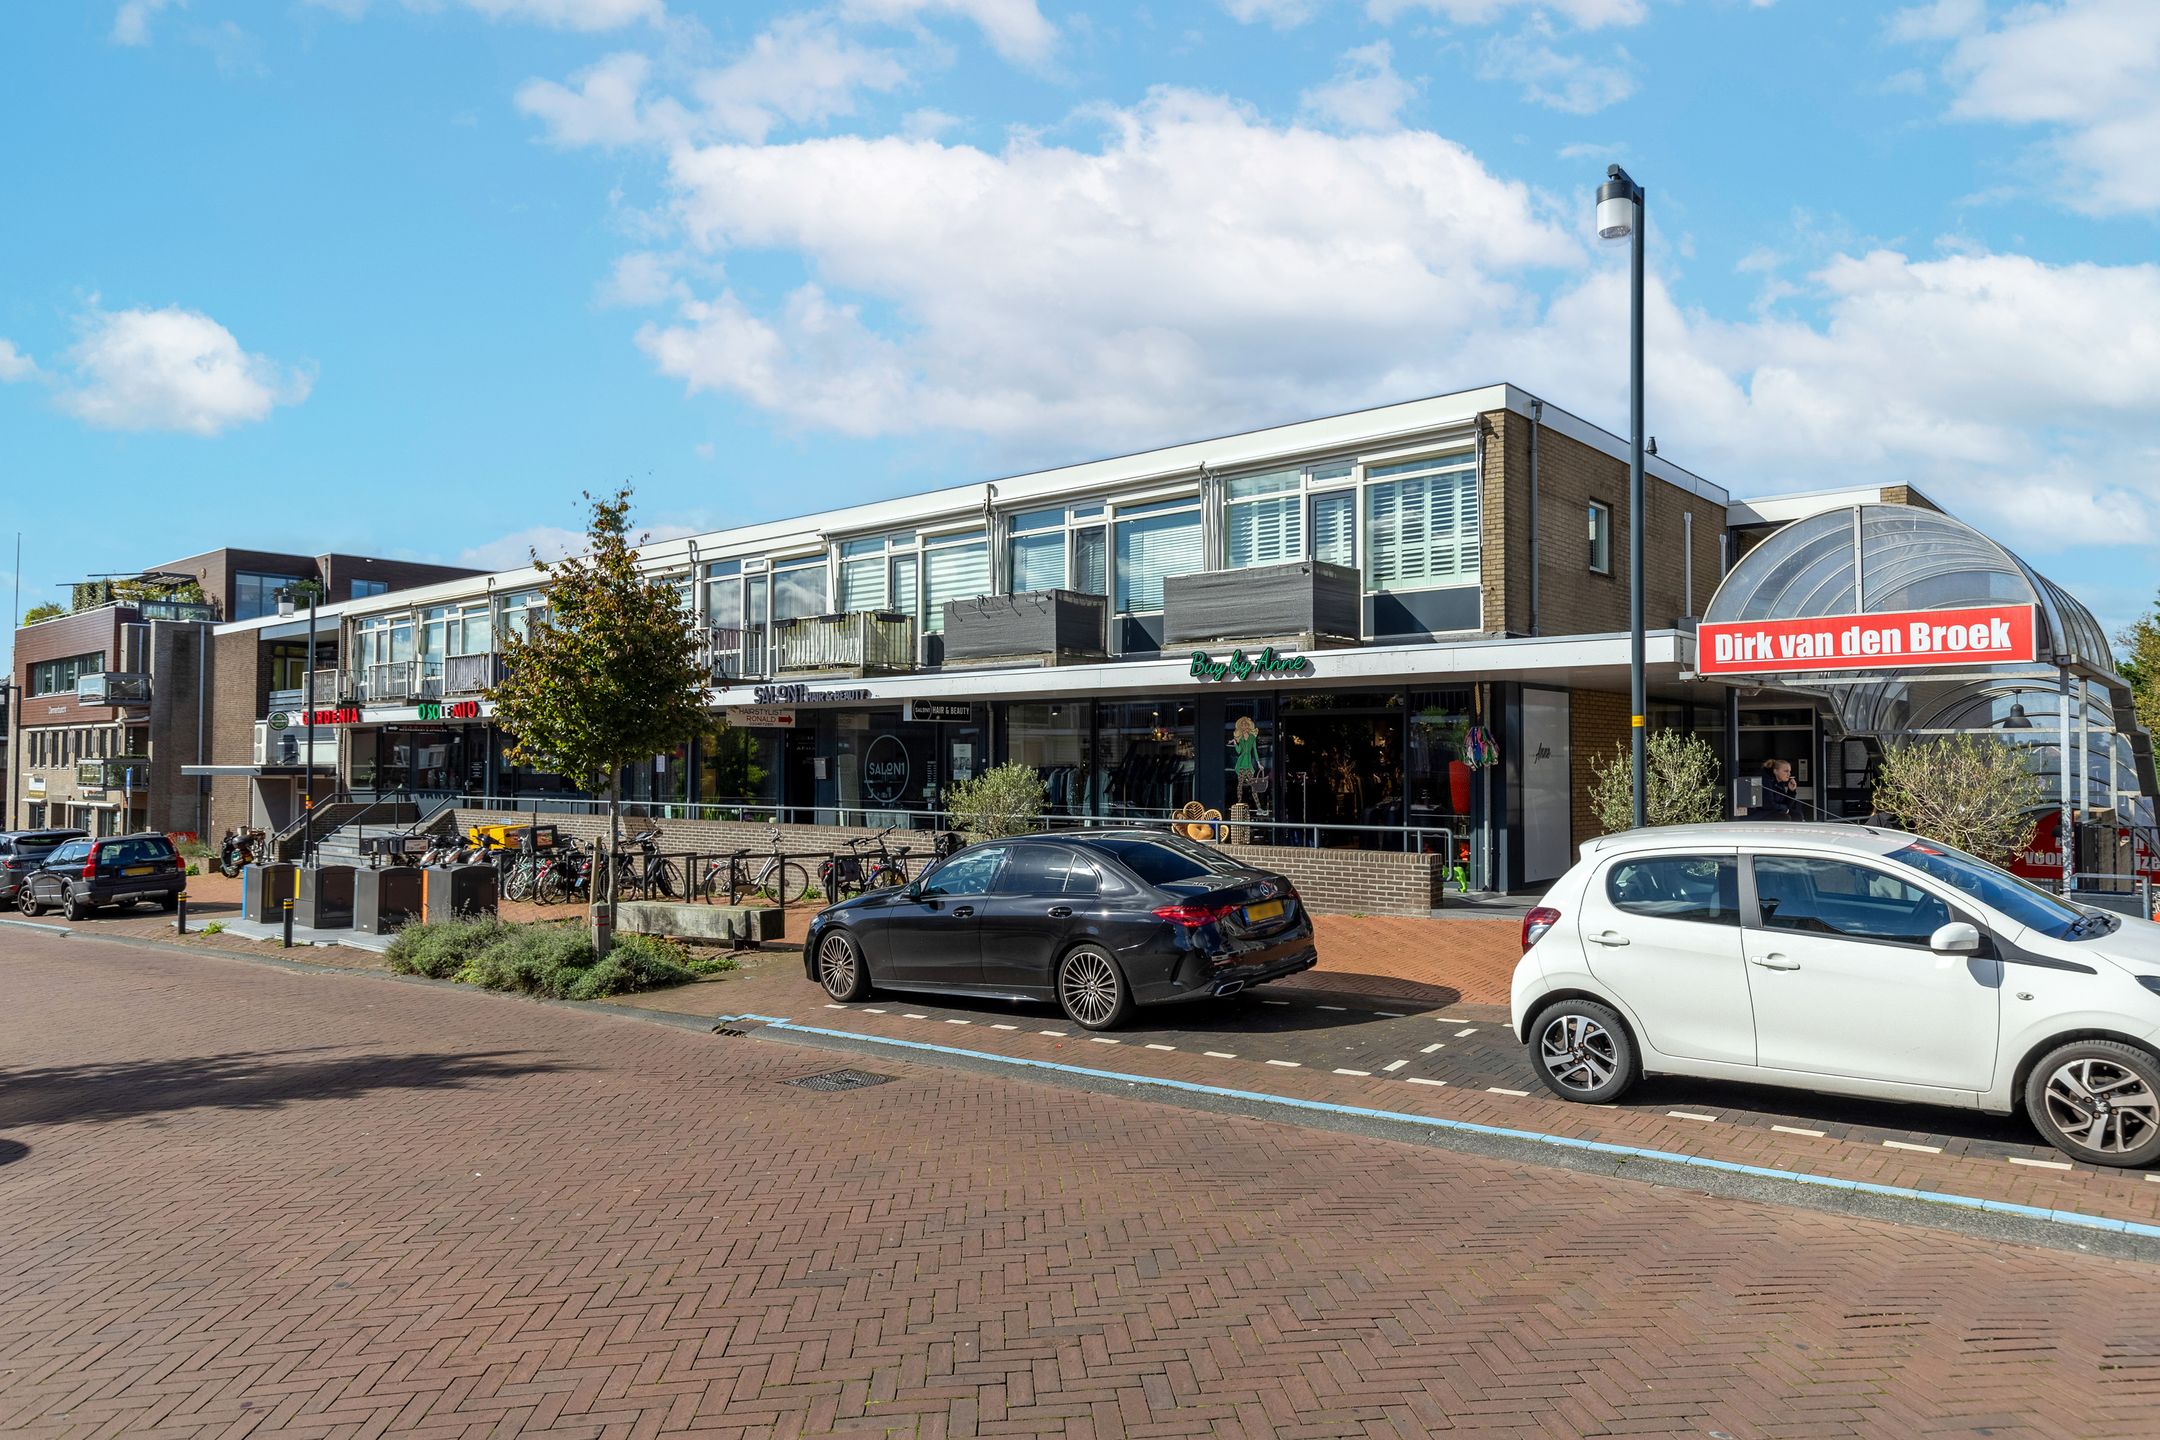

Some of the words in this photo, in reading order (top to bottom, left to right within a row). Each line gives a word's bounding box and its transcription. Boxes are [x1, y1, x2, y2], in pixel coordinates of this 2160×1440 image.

[1715, 631, 1775, 661] Dirk
[1779, 633, 1834, 659] van
[1841, 626, 1902, 656] den
[1909, 618, 2012, 651] Broek
[1190, 651, 1228, 681] Buy
[1229, 649, 1253, 680] by
[1255, 647, 1307, 673] Anne
[807, 692, 826, 702] HAIR
[826, 691, 834, 702] &
[834, 689, 866, 701] BEAUTY
[303, 707, 358, 725] GRDENIA
[418, 703, 427, 720] O
[932, 706, 944, 714] HAIR
[950, 707, 969, 715] BEAUTY
[869, 762, 905, 775] SALON1
